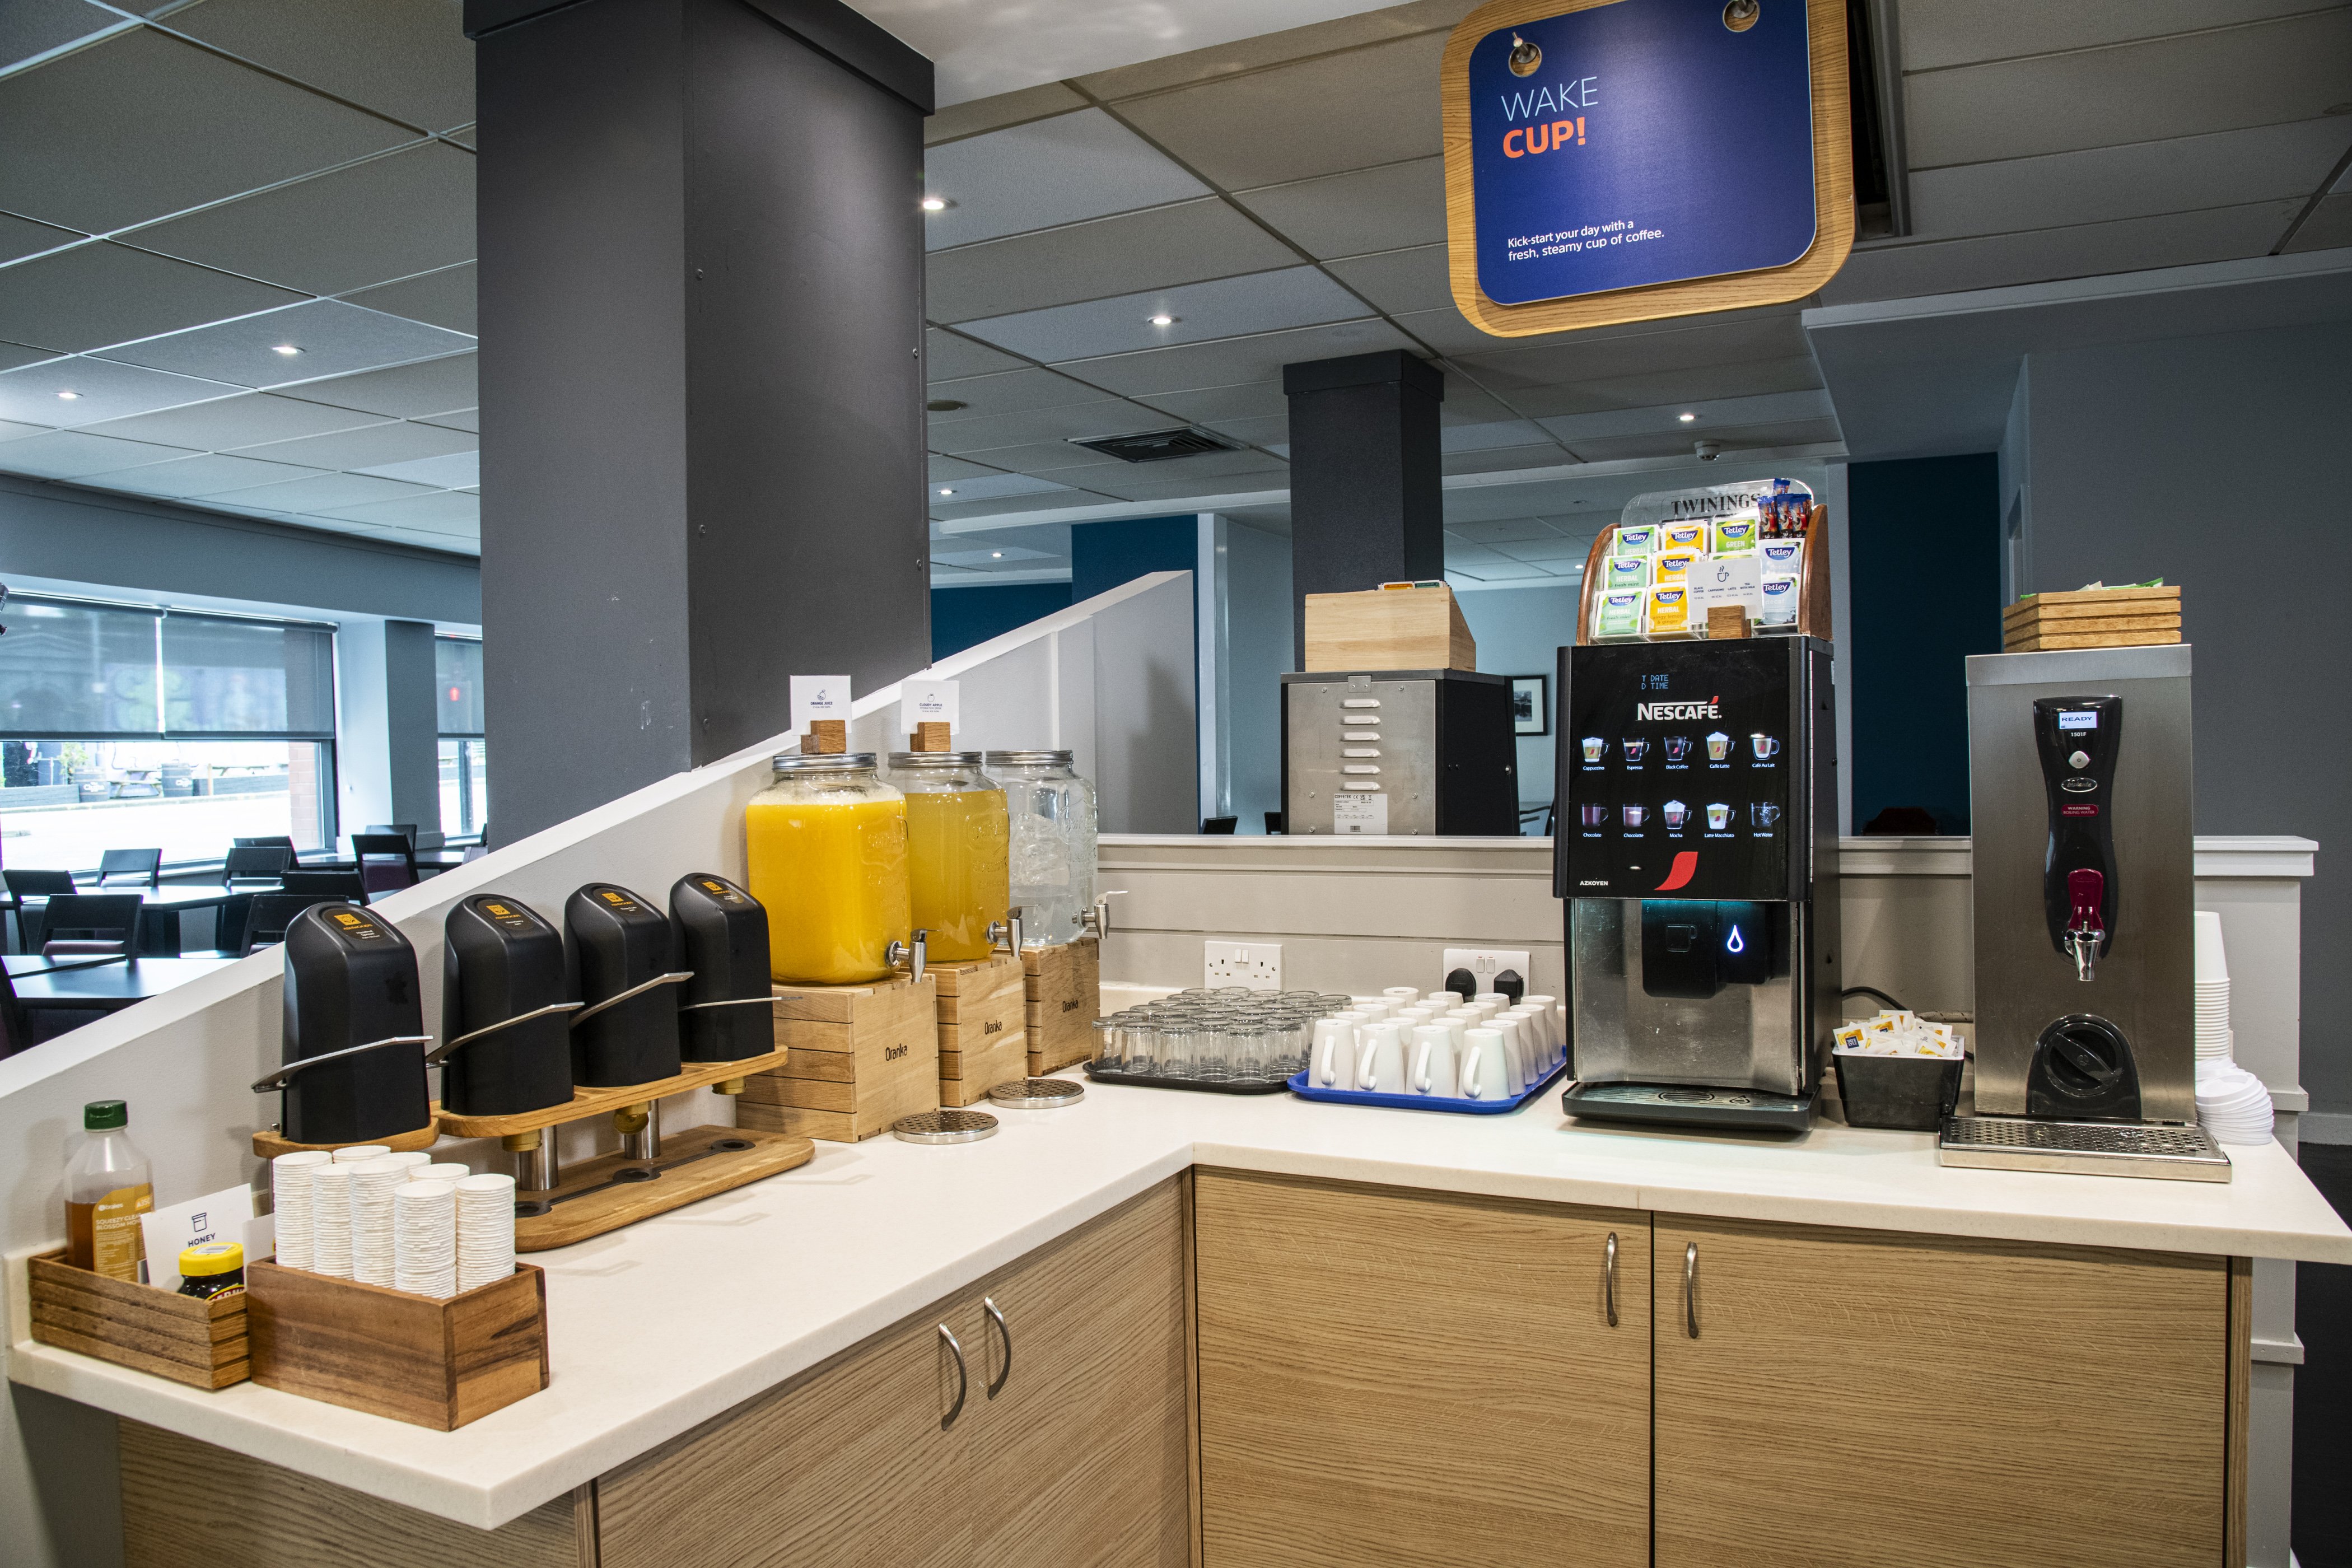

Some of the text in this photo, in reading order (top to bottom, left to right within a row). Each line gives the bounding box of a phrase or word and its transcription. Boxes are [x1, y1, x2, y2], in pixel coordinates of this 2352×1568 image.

[1501, 76, 1598, 122] WAKE
[1503, 116, 1585, 158] CUP!
[1508, 232, 1553, 248] Kick-start
[1555, 228, 1579, 242] your
[1581, 226, 1599, 237] day
[1602, 220, 1625, 233] with
[1508, 229, 1665, 261] fresh, steamy cup of coffee.
[1671, 493, 1760, 515] TWININGS
[1674, 530, 1696, 540] Tetley
[1724, 525, 1747, 535] Tetley
[1624, 533, 1647, 542] Tetley
[1768, 548, 1792, 558] Tetley
[1616, 561, 1639, 570] Tetley
[1664, 560, 1687, 569] Tetley
[1763, 584, 1788, 592] Tetley
[1658, 592, 1681, 601] Tetley
[1062, 998, 1079, 1013] Oranka
[984, 1020, 1002, 1035] Oranka
[885, 1043, 908, 1062] Oranka
[96, 1216, 124, 1225] SQUEEZY
[96, 1222, 126, 1230] BLOSSOM
[188, 1233, 216, 1248] HONEY
